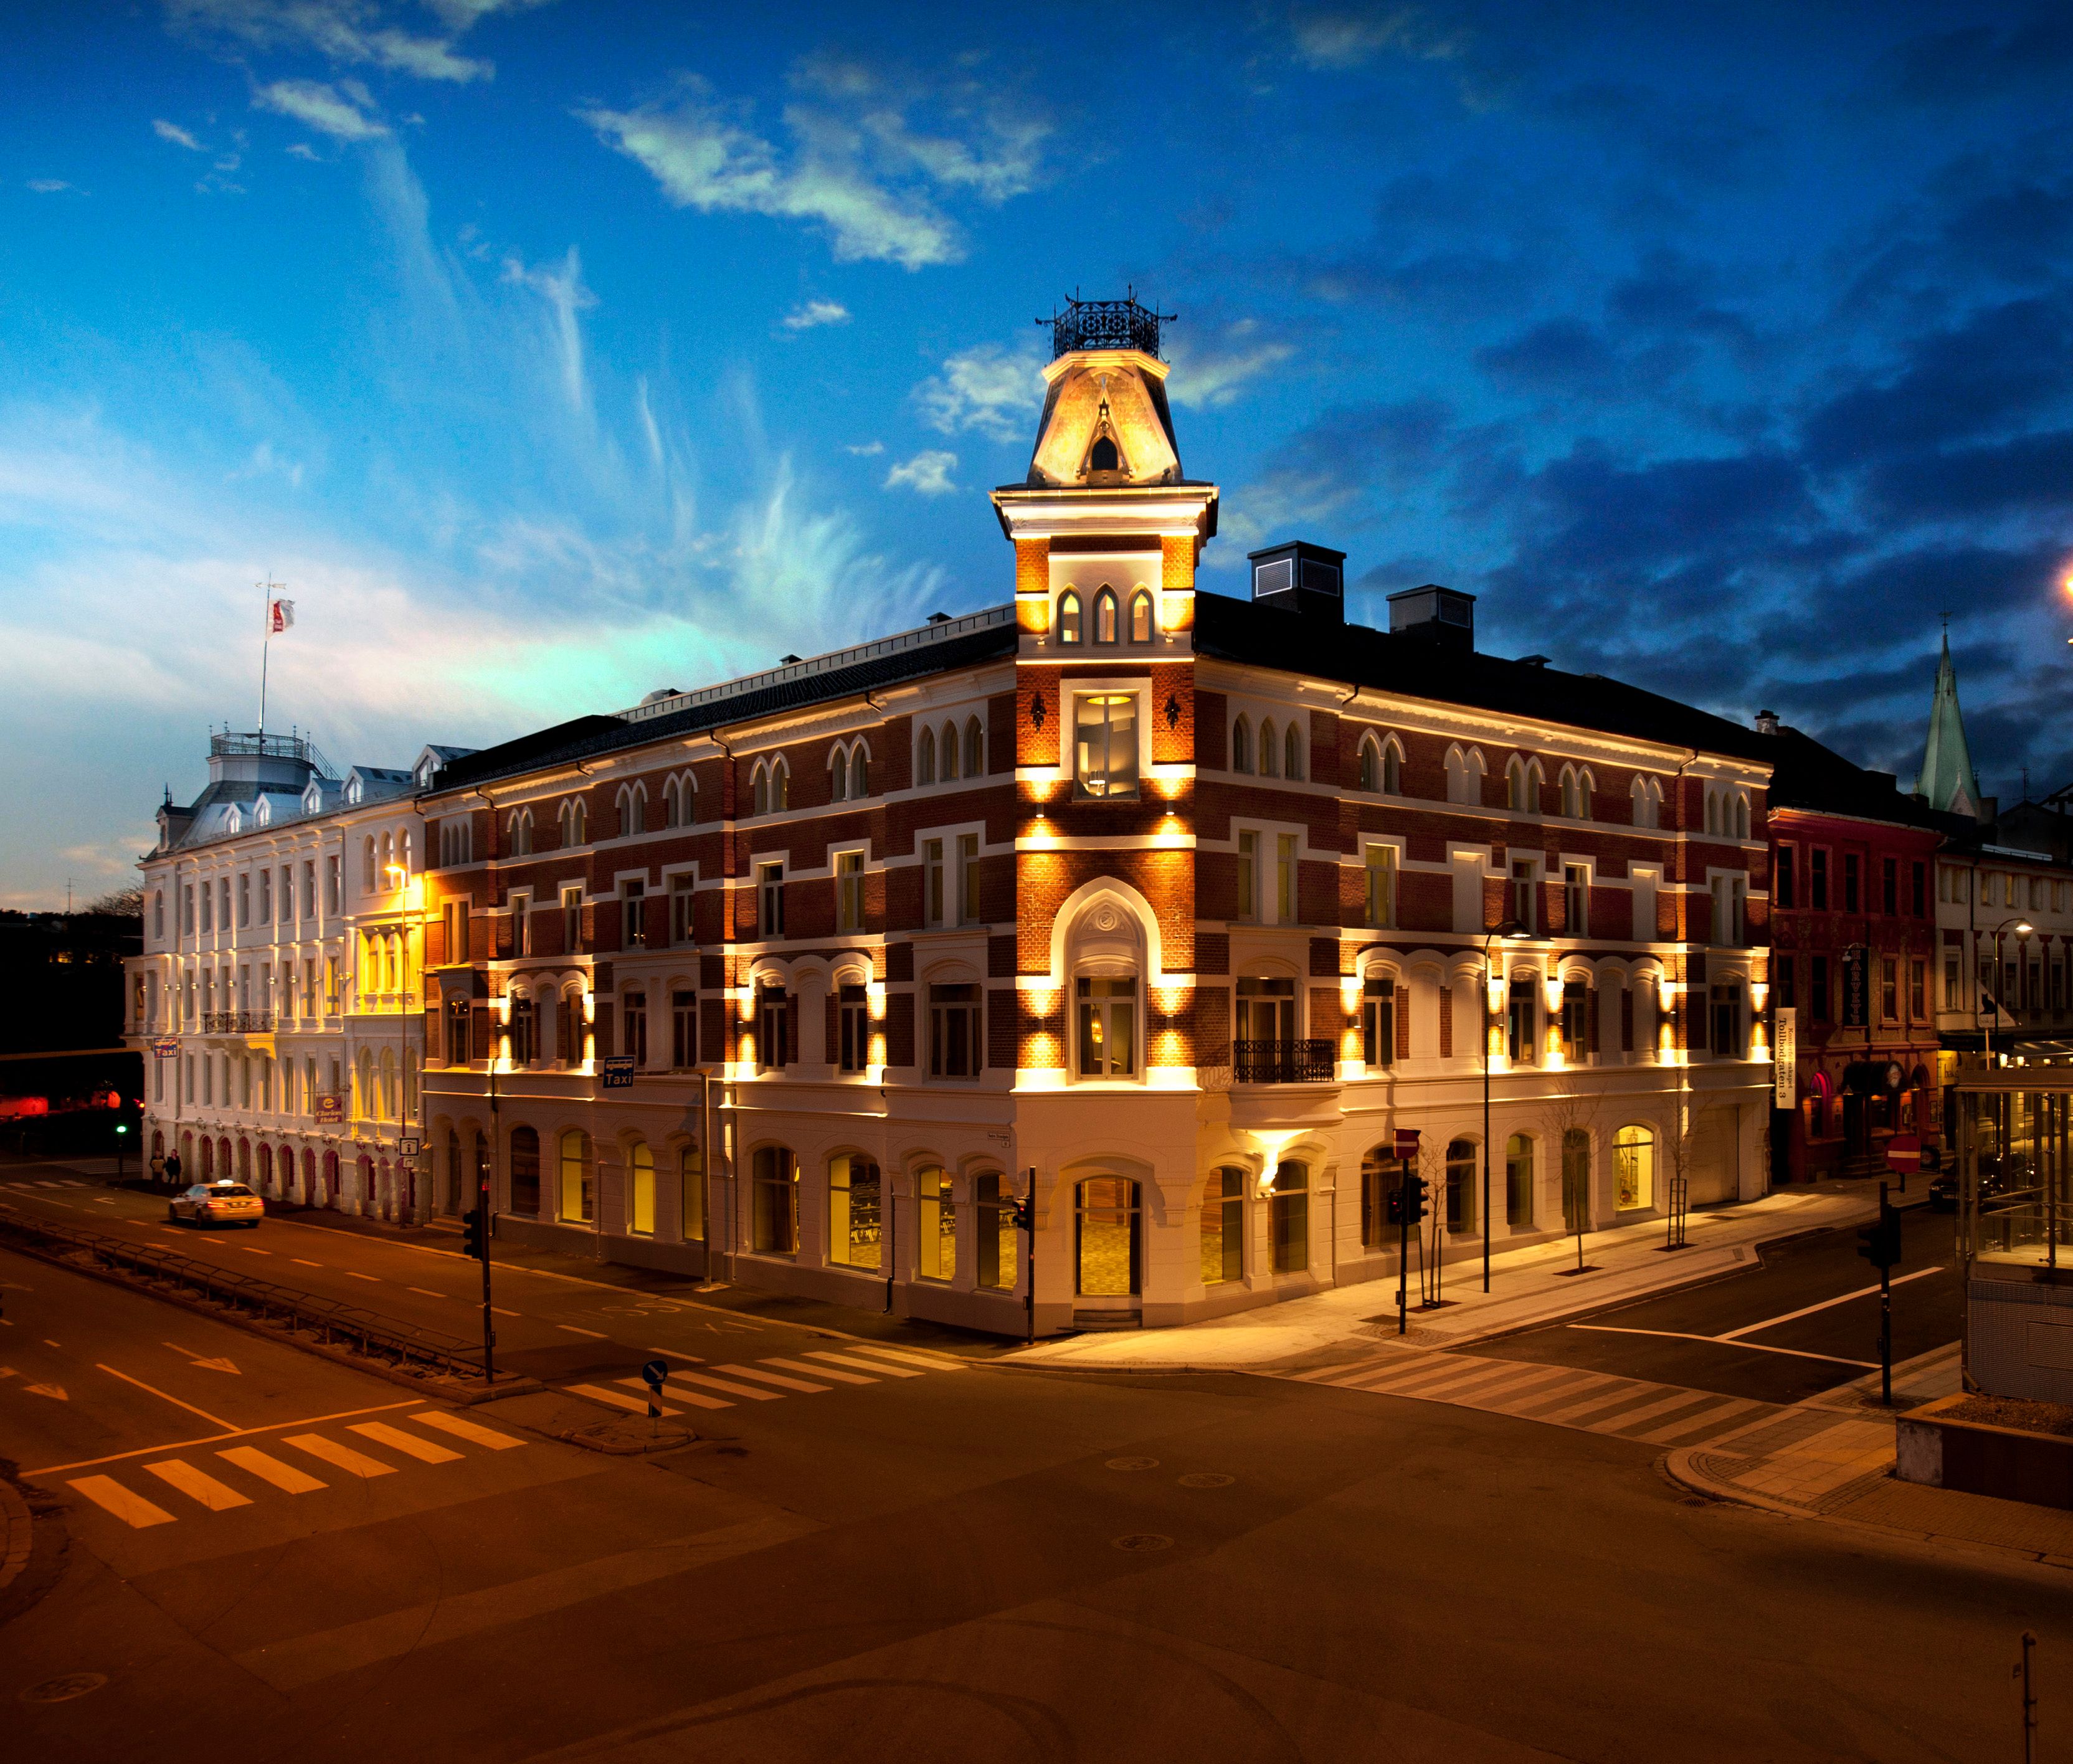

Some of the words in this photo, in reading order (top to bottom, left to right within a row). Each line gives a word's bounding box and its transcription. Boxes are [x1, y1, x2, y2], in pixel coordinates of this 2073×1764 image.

[156, 1048, 177, 1057] Taxi
[1777, 1018, 1787, 1088] Tollbodgaten
[605, 1073, 632, 1085] Taxi
